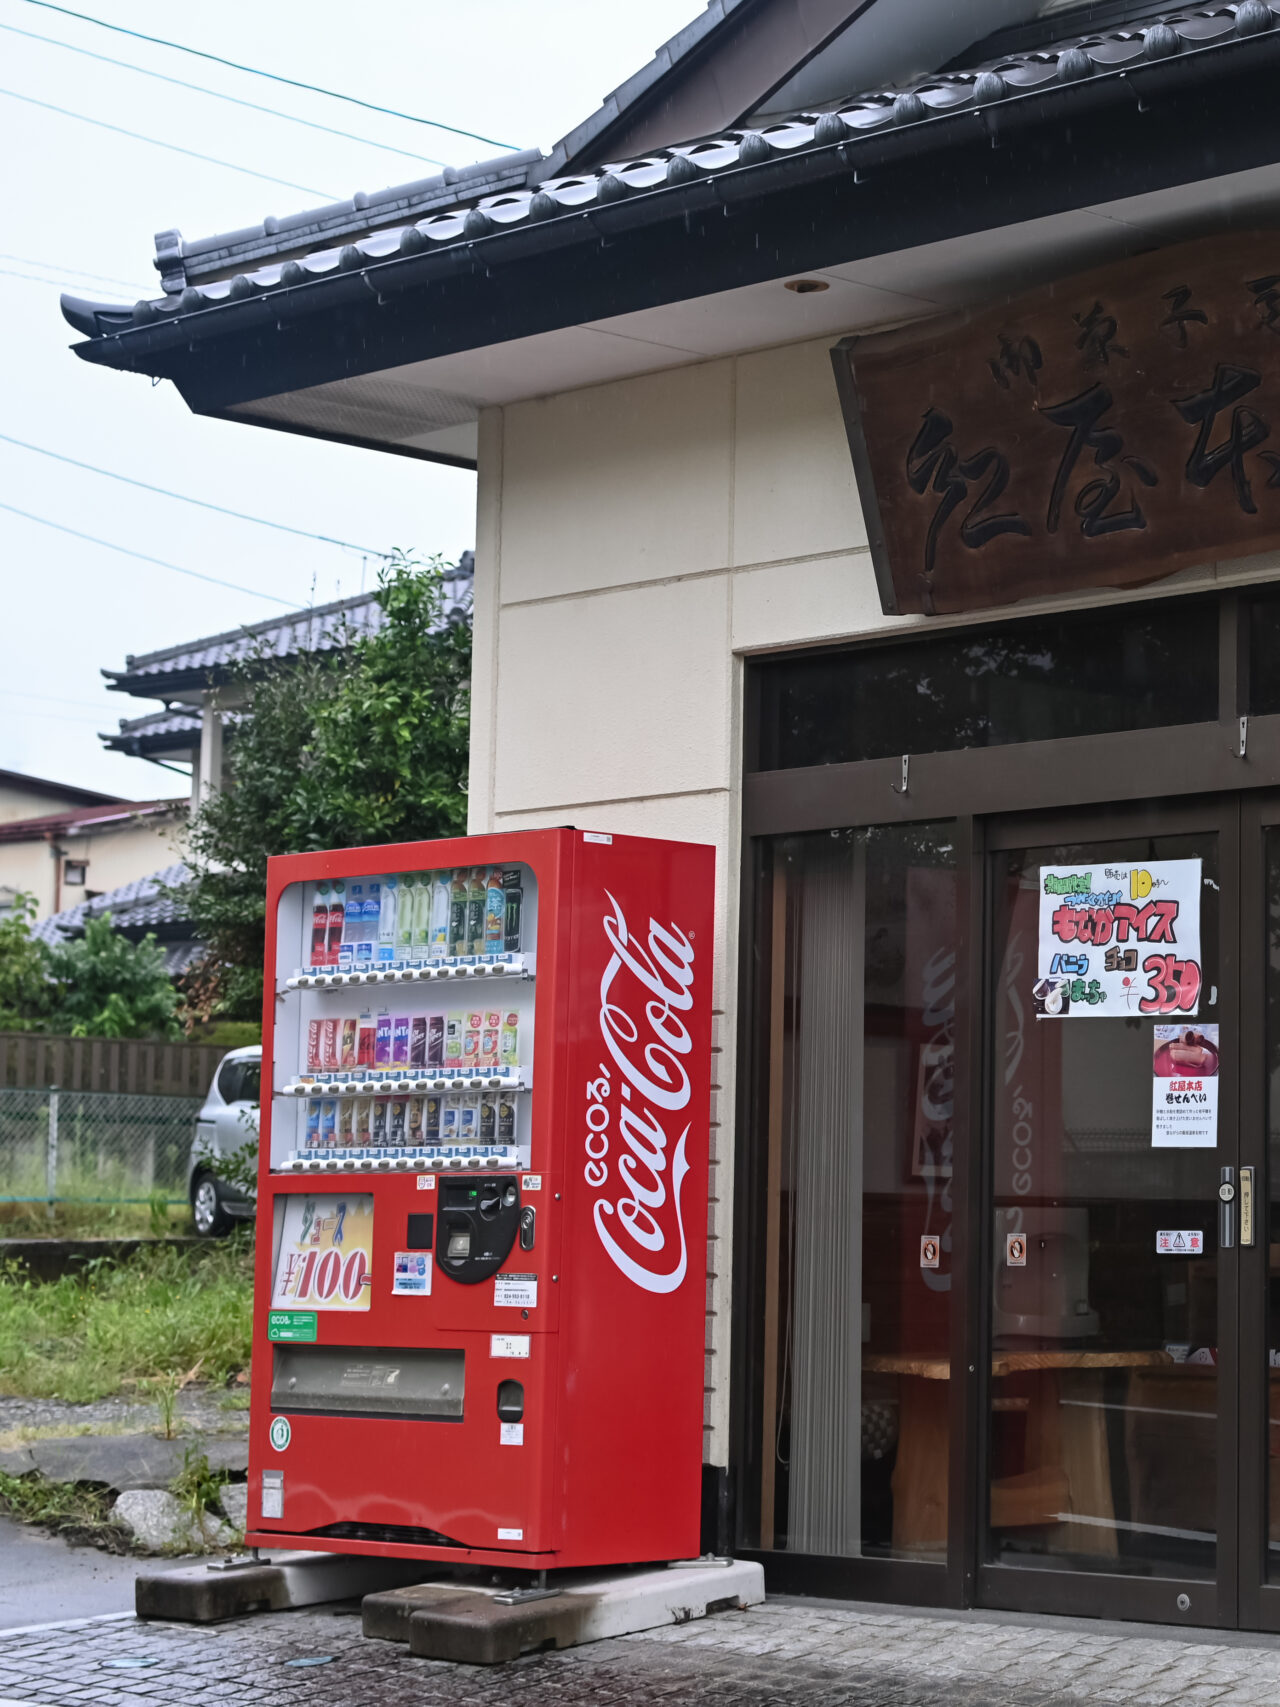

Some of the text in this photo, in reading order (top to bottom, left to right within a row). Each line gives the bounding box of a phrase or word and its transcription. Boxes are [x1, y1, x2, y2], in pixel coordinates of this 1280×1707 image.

[1052, 900, 1180, 946] もなかアイス
[1049, 953, 1090, 976] バニラ
[1104, 945, 1138, 972] チョコ
[593, 888, 695, 1294] Coca-Cola
[1169, 1080, 1203, 1092] 紅屋本店
